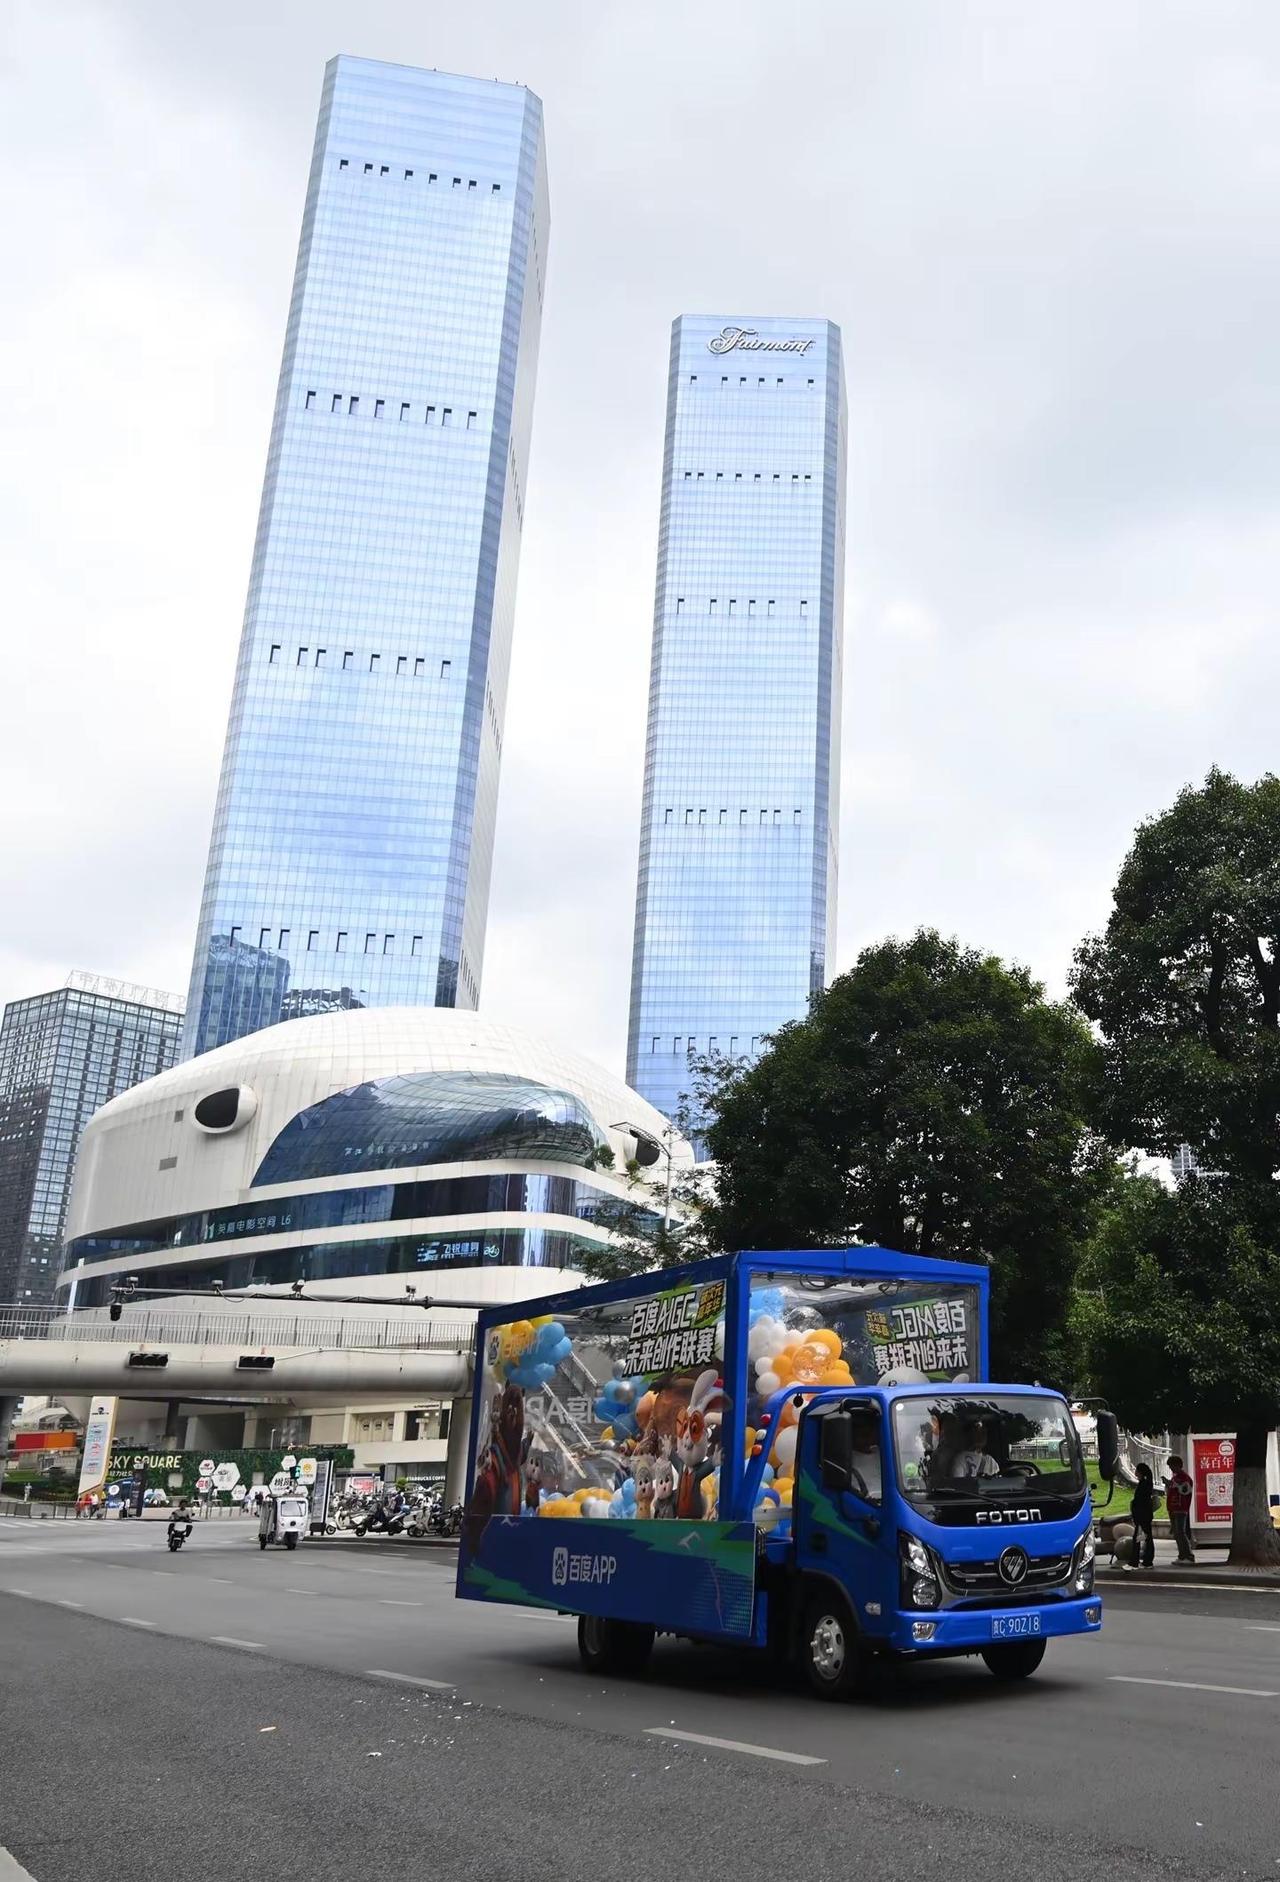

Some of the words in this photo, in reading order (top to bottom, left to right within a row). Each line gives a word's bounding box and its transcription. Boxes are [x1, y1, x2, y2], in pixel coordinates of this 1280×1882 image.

[707, 326, 815, 356] Fairmont
[630, 1292, 697, 1339] 百度AIGC
[623, 1327, 715, 1375] 未来创作联赛
[107, 1456, 131, 1469] SKY
[976, 1509, 1041, 1524] FOTON
[569, 1554, 617, 1585] 百度APP
